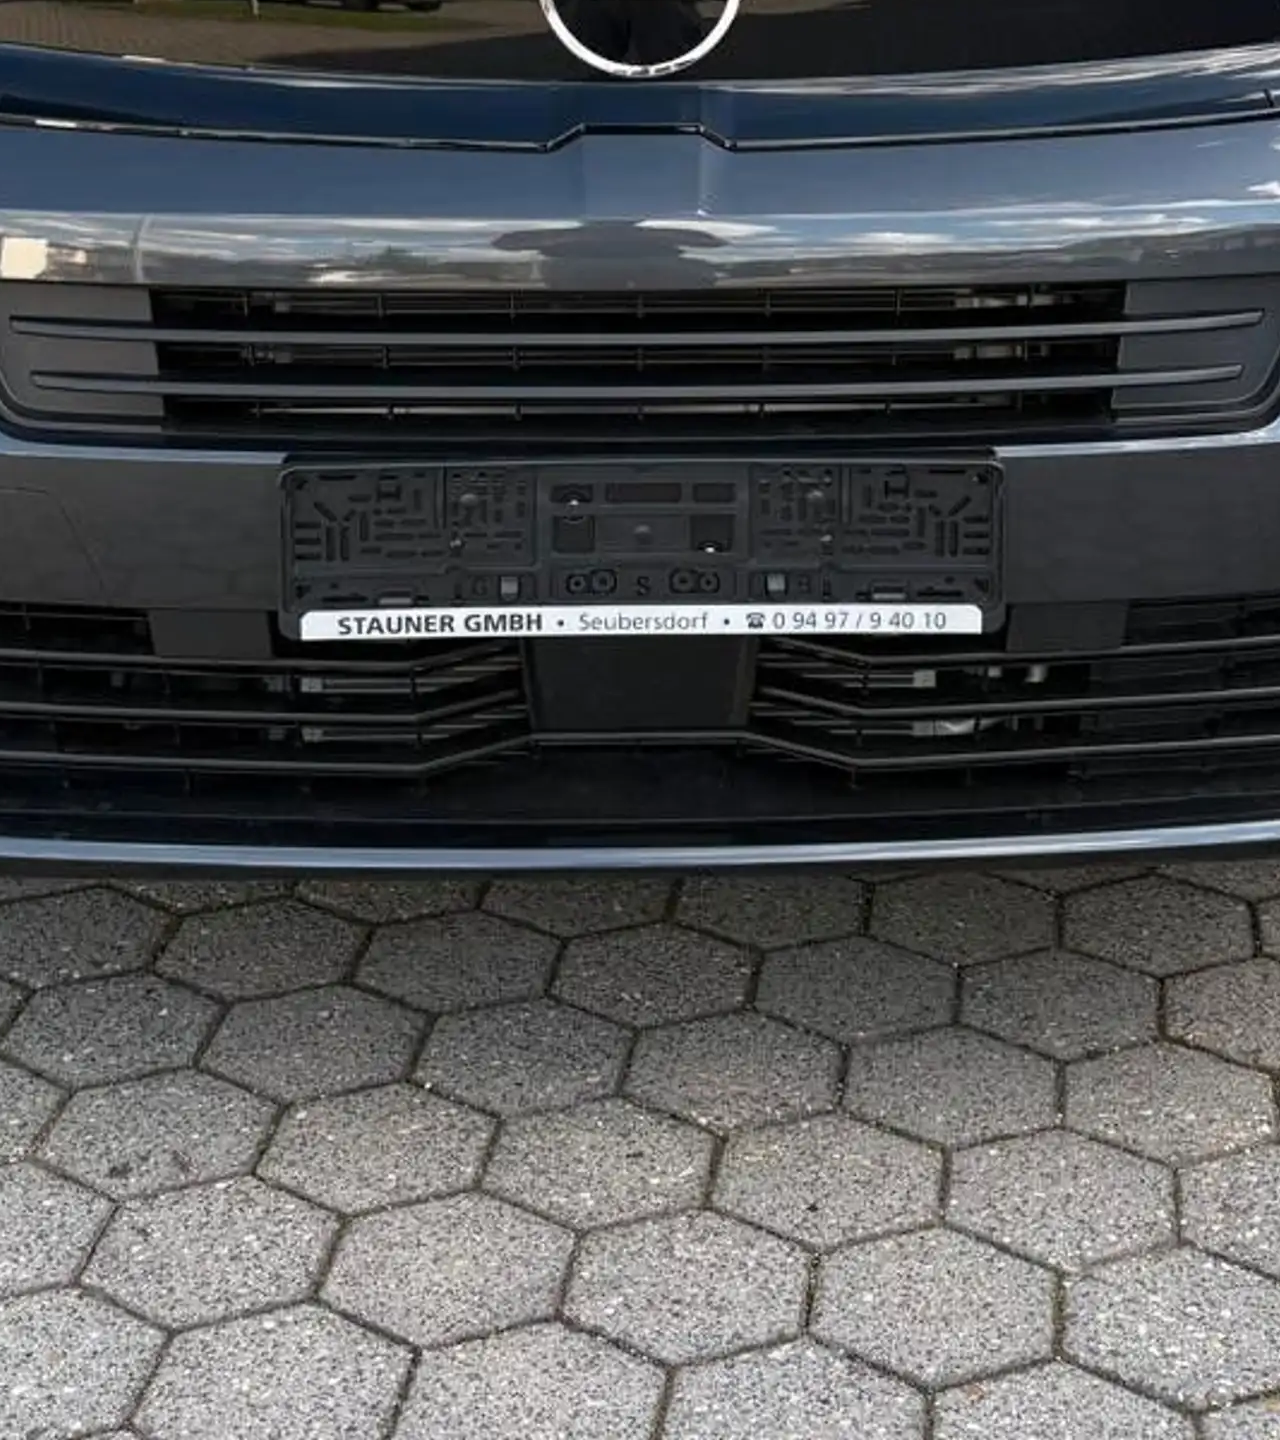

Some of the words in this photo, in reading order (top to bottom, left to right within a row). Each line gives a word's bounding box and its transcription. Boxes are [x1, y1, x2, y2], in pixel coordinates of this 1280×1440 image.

[337, 614, 454, 636] STAUNER
[464, 613, 543, 633] GMBH
[579, 611, 708, 631] Seubersdorf
[772, 612, 785, 630] 0
[792, 612, 817, 630] 94
[825, 611, 849, 630] 97
[869, 612, 882, 630] 9
[888, 611, 914, 630] 40
[924, 611, 946, 630] 10
